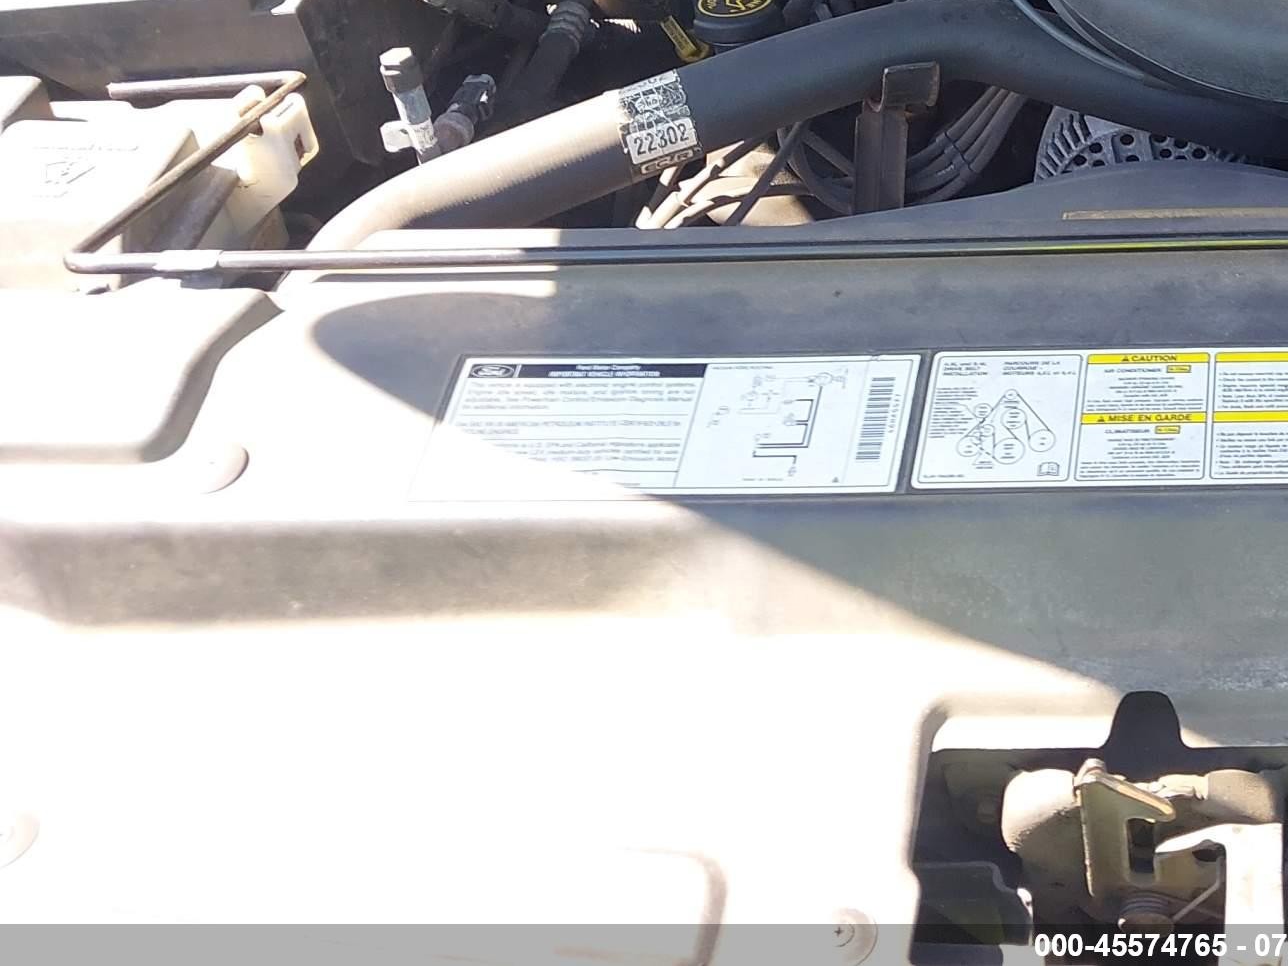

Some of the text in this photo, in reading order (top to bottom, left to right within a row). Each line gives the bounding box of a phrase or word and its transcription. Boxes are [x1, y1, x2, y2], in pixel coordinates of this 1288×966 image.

[634, 123, 690, 156] 22302
[1108, 414, 1192, 422] MISE EN GARDE
